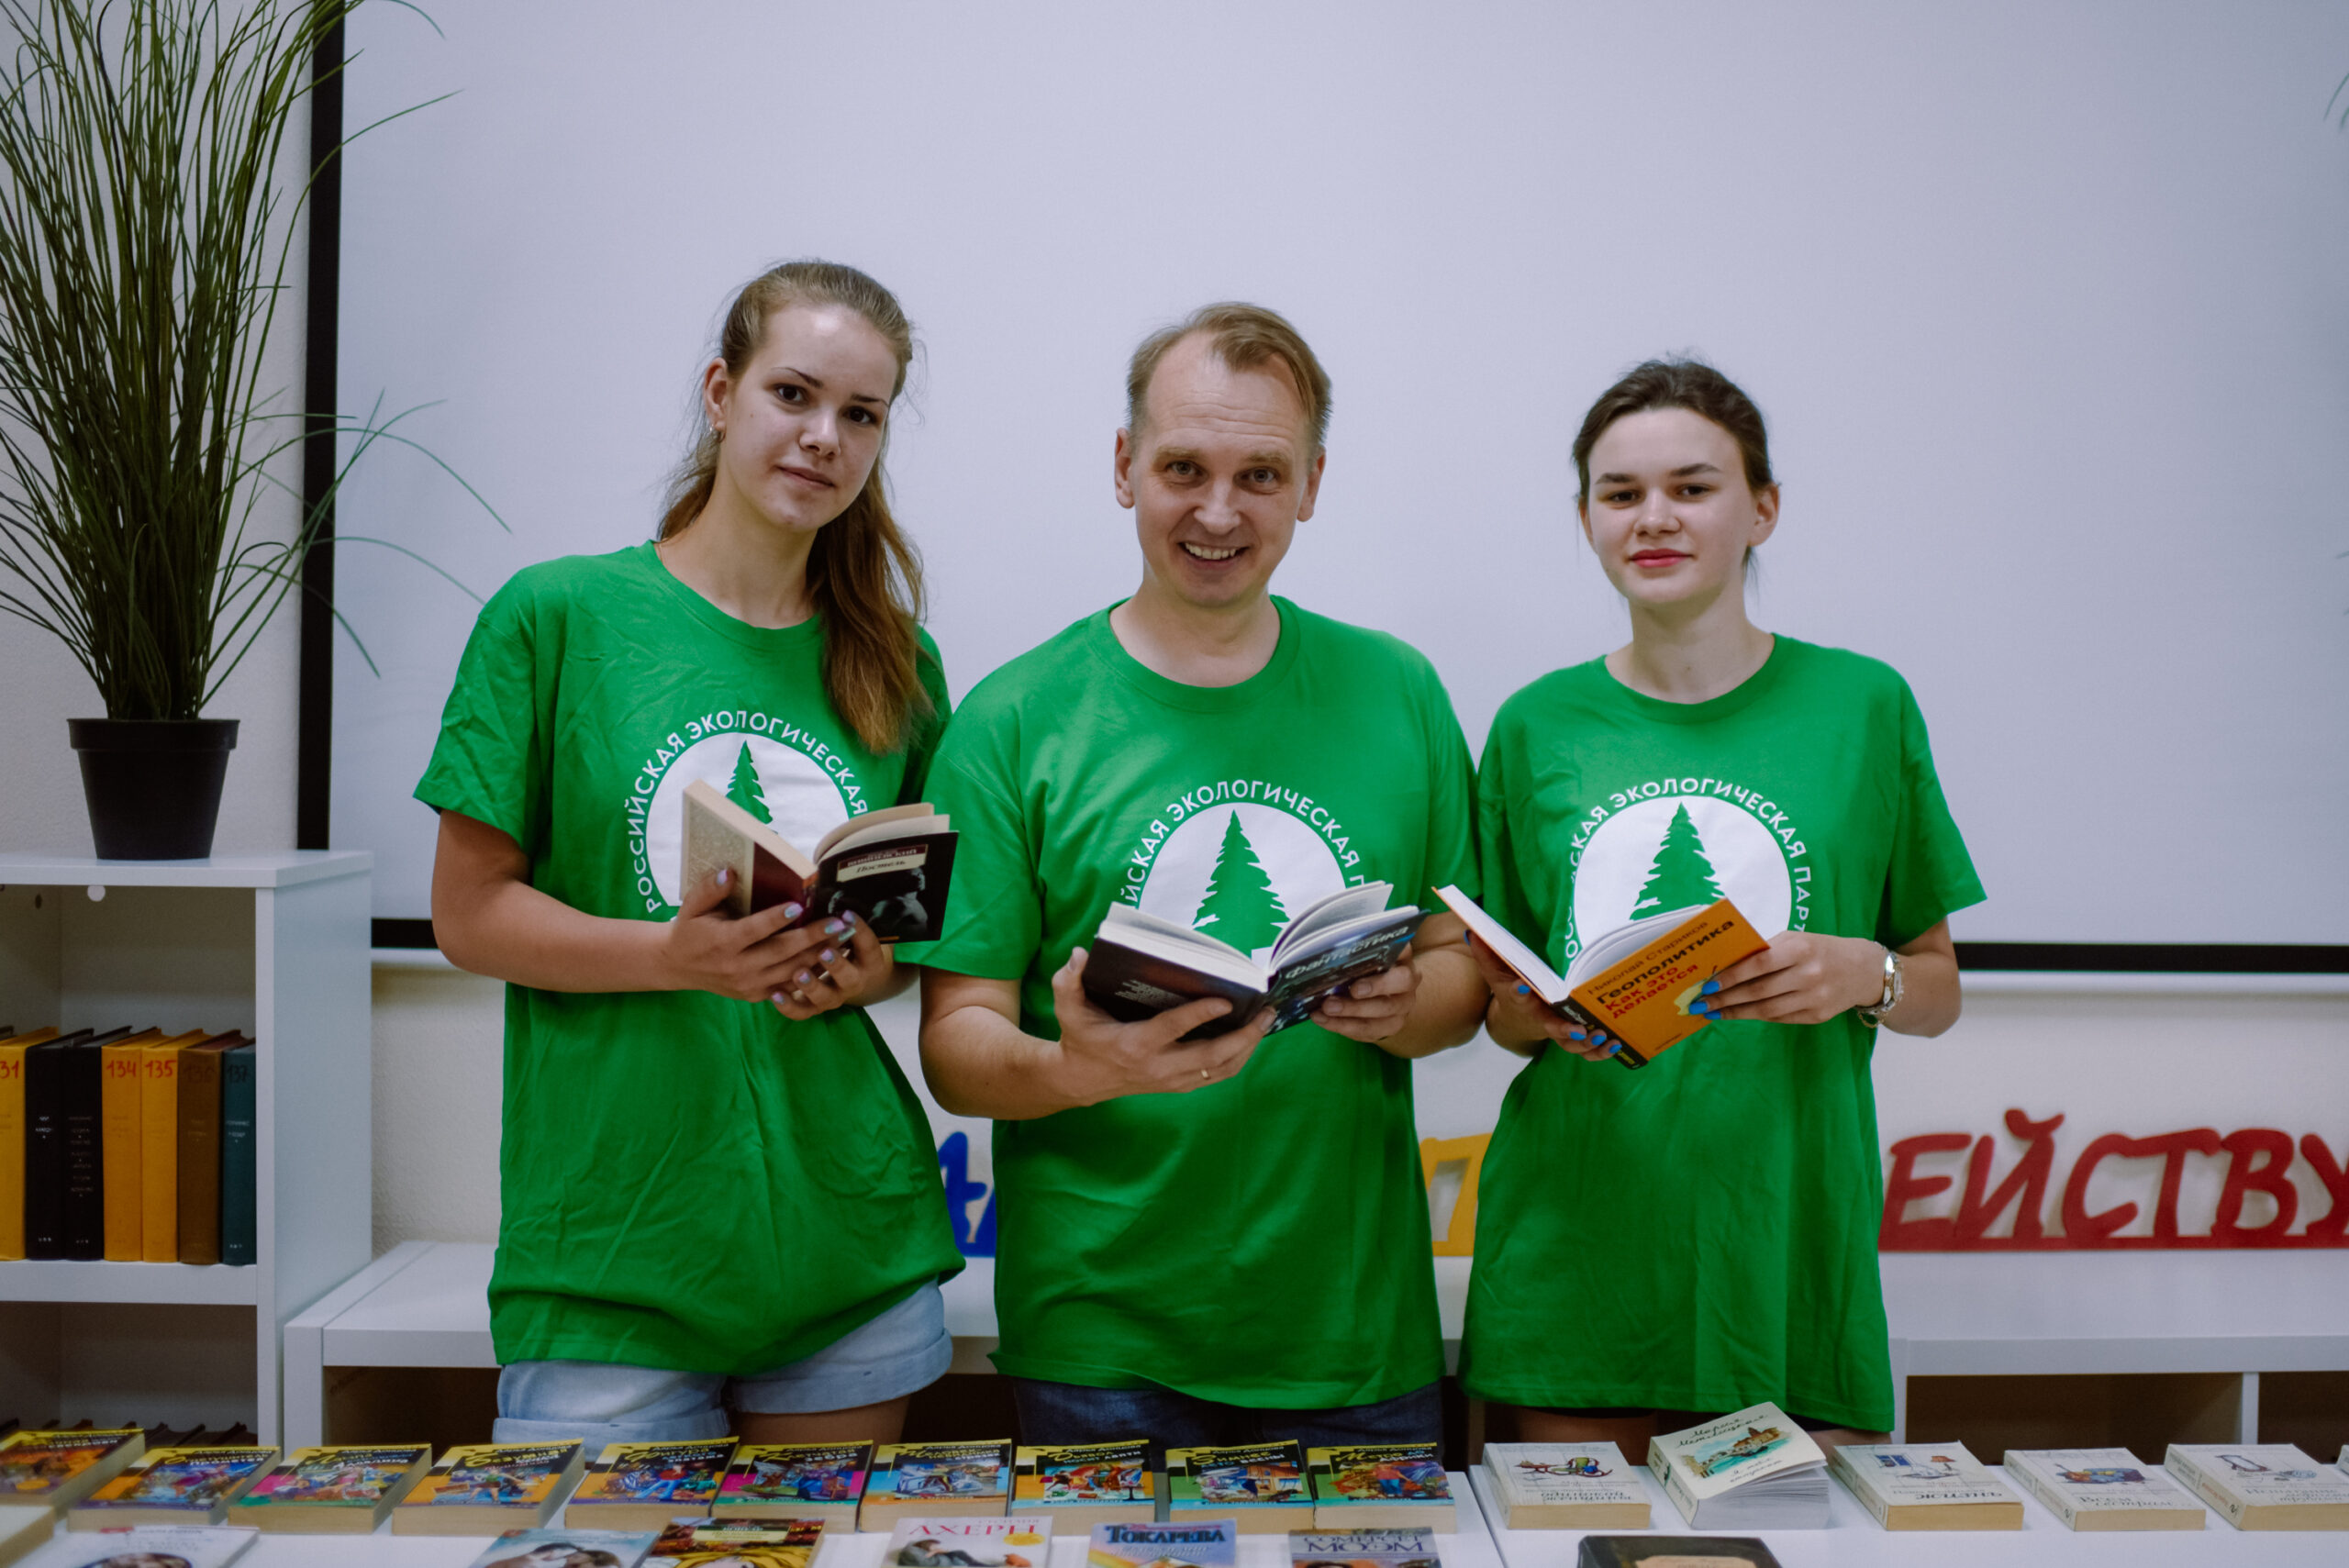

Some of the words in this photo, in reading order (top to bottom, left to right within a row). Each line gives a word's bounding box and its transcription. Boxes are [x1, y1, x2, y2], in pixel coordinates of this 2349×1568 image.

[624, 732, 685, 914] РОССИЙСКАЯ
[685, 710, 868, 815] ЭКОЛОГИЧЕСКАЯ
[1609, 778, 1807, 858] ЭКОЛОГИЧЕСКАЯ
[1119, 819, 1170, 909] ЙСКАЯ
[1166, 779, 1360, 868] ЭКОЛОГИЧЕСКАЯ
[1647, 921, 1709, 962] Стариков
[1597, 920, 1734, 1005] Геополитика
[1605, 989, 1642, 1011] Как
[1646, 967, 1678, 988] это
[1612, 965, 1698, 1019] делается
[106, 1060, 138, 1078] 134
[145, 1060, 177, 1078] 135
[1192, 1451, 1272, 1465] Зимнее
[1240, 1453, 1286, 1464] весны
[1335, 1451, 1403, 1462] Метро
[909, 1525, 1035, 1535] АХЕРН
[1105, 1525, 1226, 1543] ТОКАРЕВА
[1308, 1542, 1423, 1552] МОЭМ
